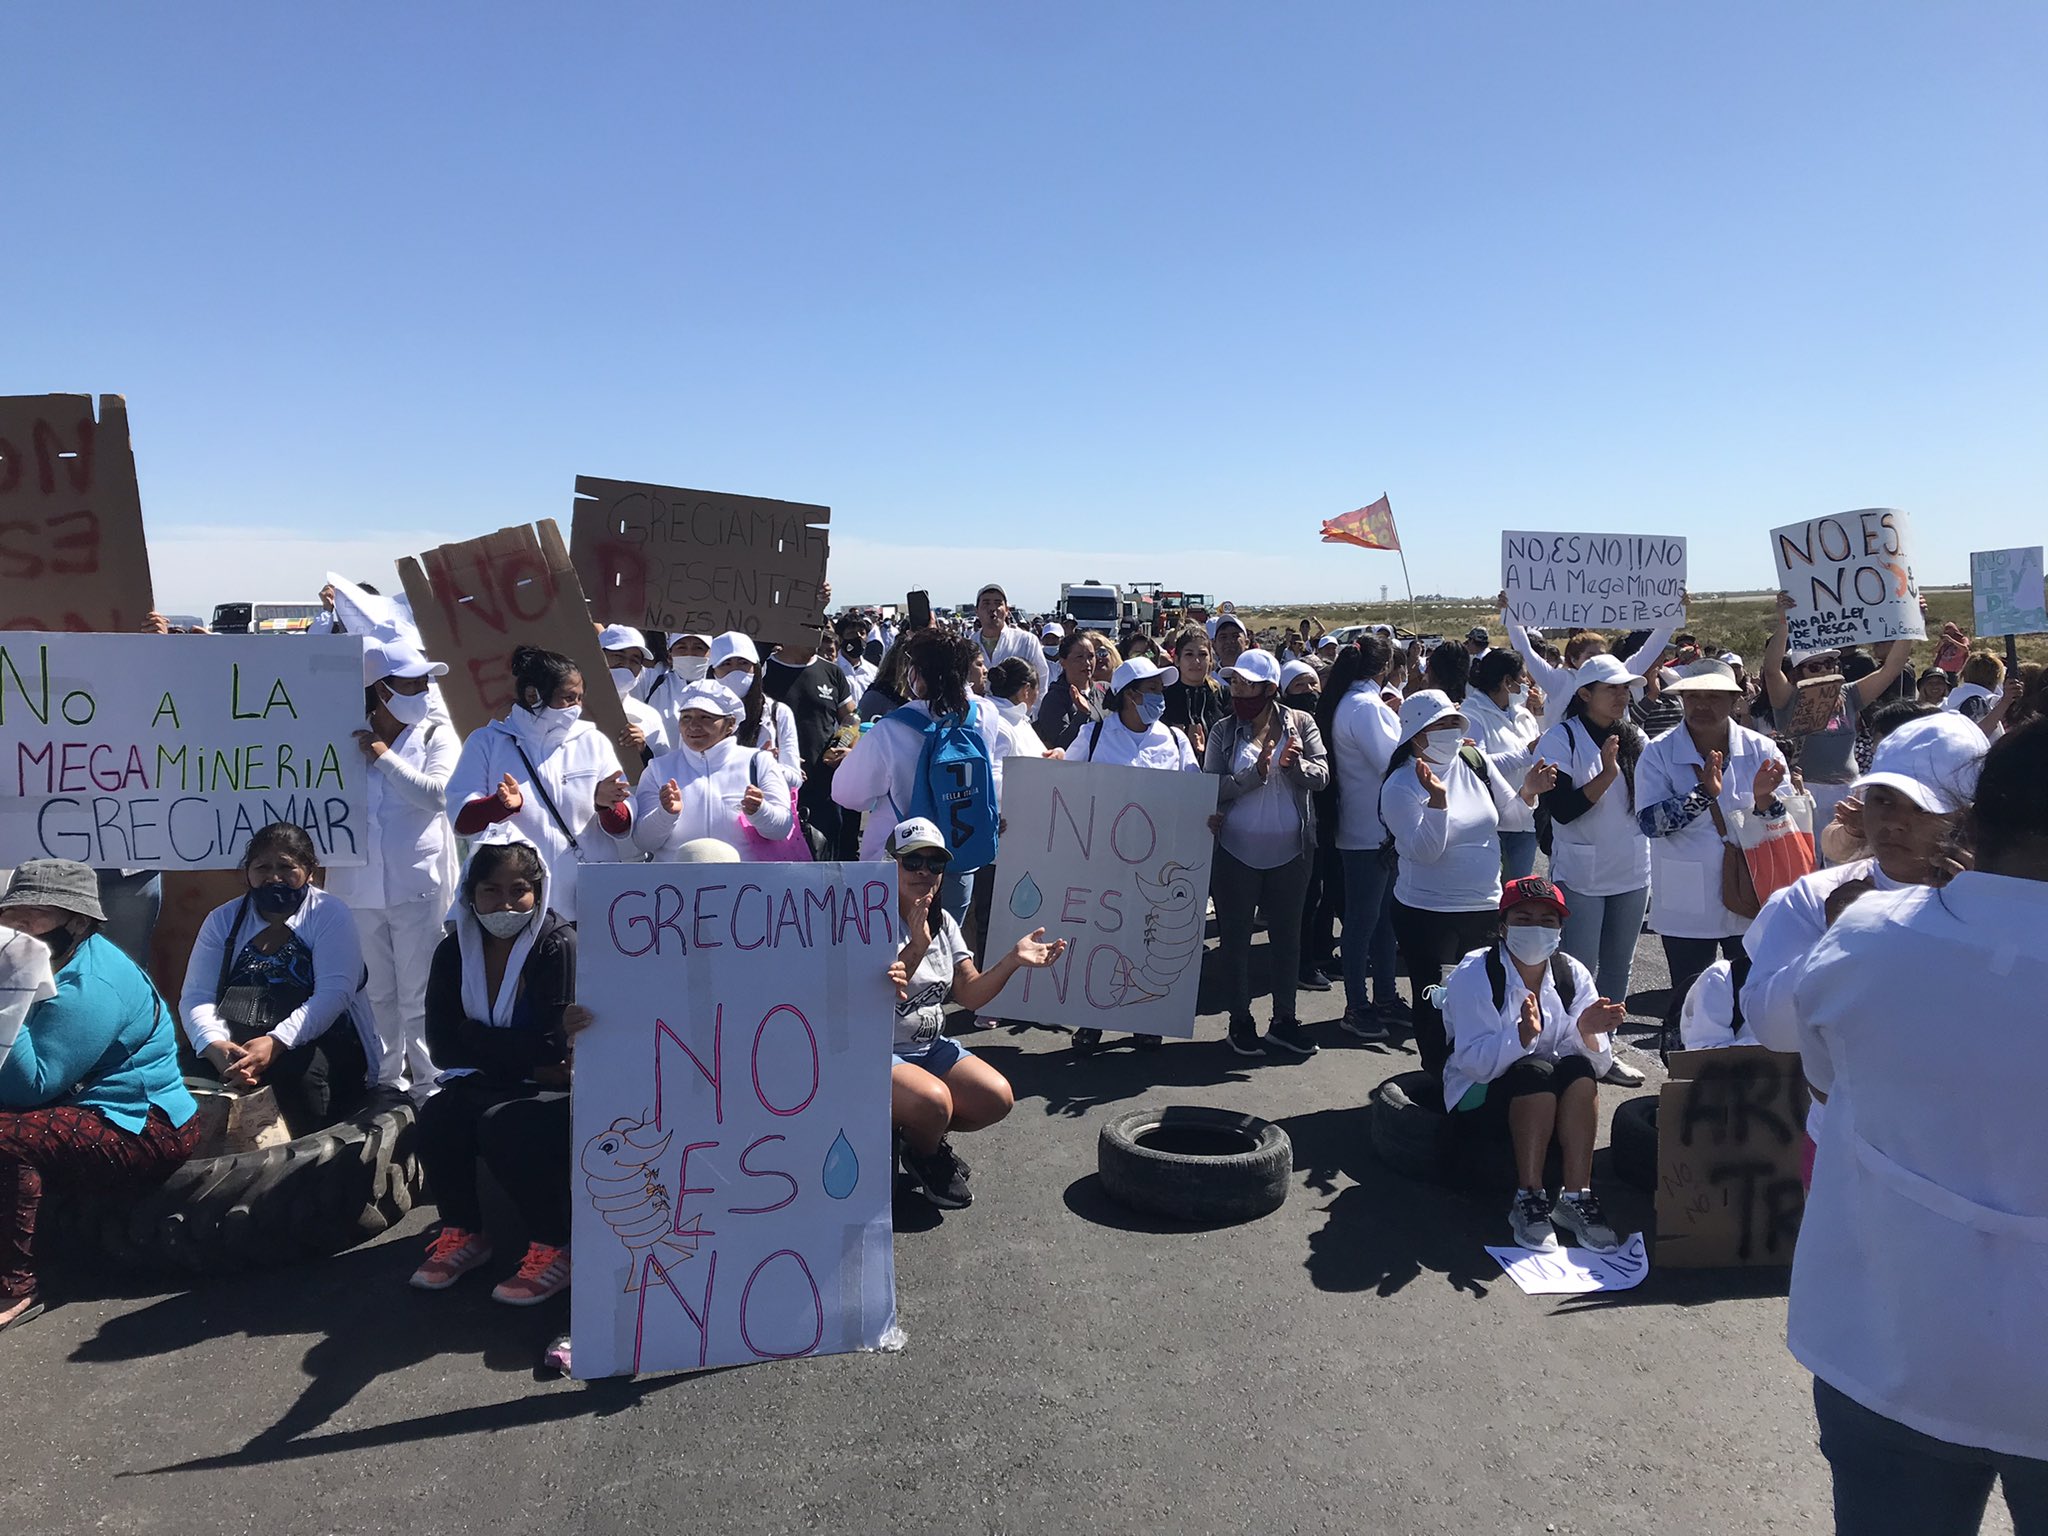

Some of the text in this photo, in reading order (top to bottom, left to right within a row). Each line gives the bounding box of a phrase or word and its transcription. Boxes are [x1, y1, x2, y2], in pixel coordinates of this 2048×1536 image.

[1645, 538, 1683, 568] NO
[1977, 548, 2036, 571] NO A
[431, 551, 559, 648] NO
[1506, 564, 1521, 589] A
[1529, 566, 1557, 592] LA
[1974, 567, 2027, 595] LEY
[644, 607, 760, 635] NO ES NO
[1546, 600, 1558, 620] A
[1562, 602, 1593, 624] LEY
[1601, 604, 1628, 624] DE
[1632, 600, 1684, 623] PESCA
[1793, 628, 1811, 639] DE
[1817, 621, 1858, 637] PESCA
[1810, 615, 1820, 627] A
[1820, 611, 1836, 625] LA
[152, 691, 180, 729] A
[232, 663, 298, 720] LA
[467, 651, 515, 711] E
[1047, 785, 1157, 865] NO
[608, 880, 893, 958] GRECIAMAR
[1060, 886, 1124, 933] ES
[1022, 937, 1129, 1010] NO
[654, 1003, 820, 1133] NO
[673, 1134, 799, 1238] ES
[1500, 1254, 1567, 1283] NO
[1599, 1238, 1644, 1279] NO
[632, 1248, 824, 1376] NO
